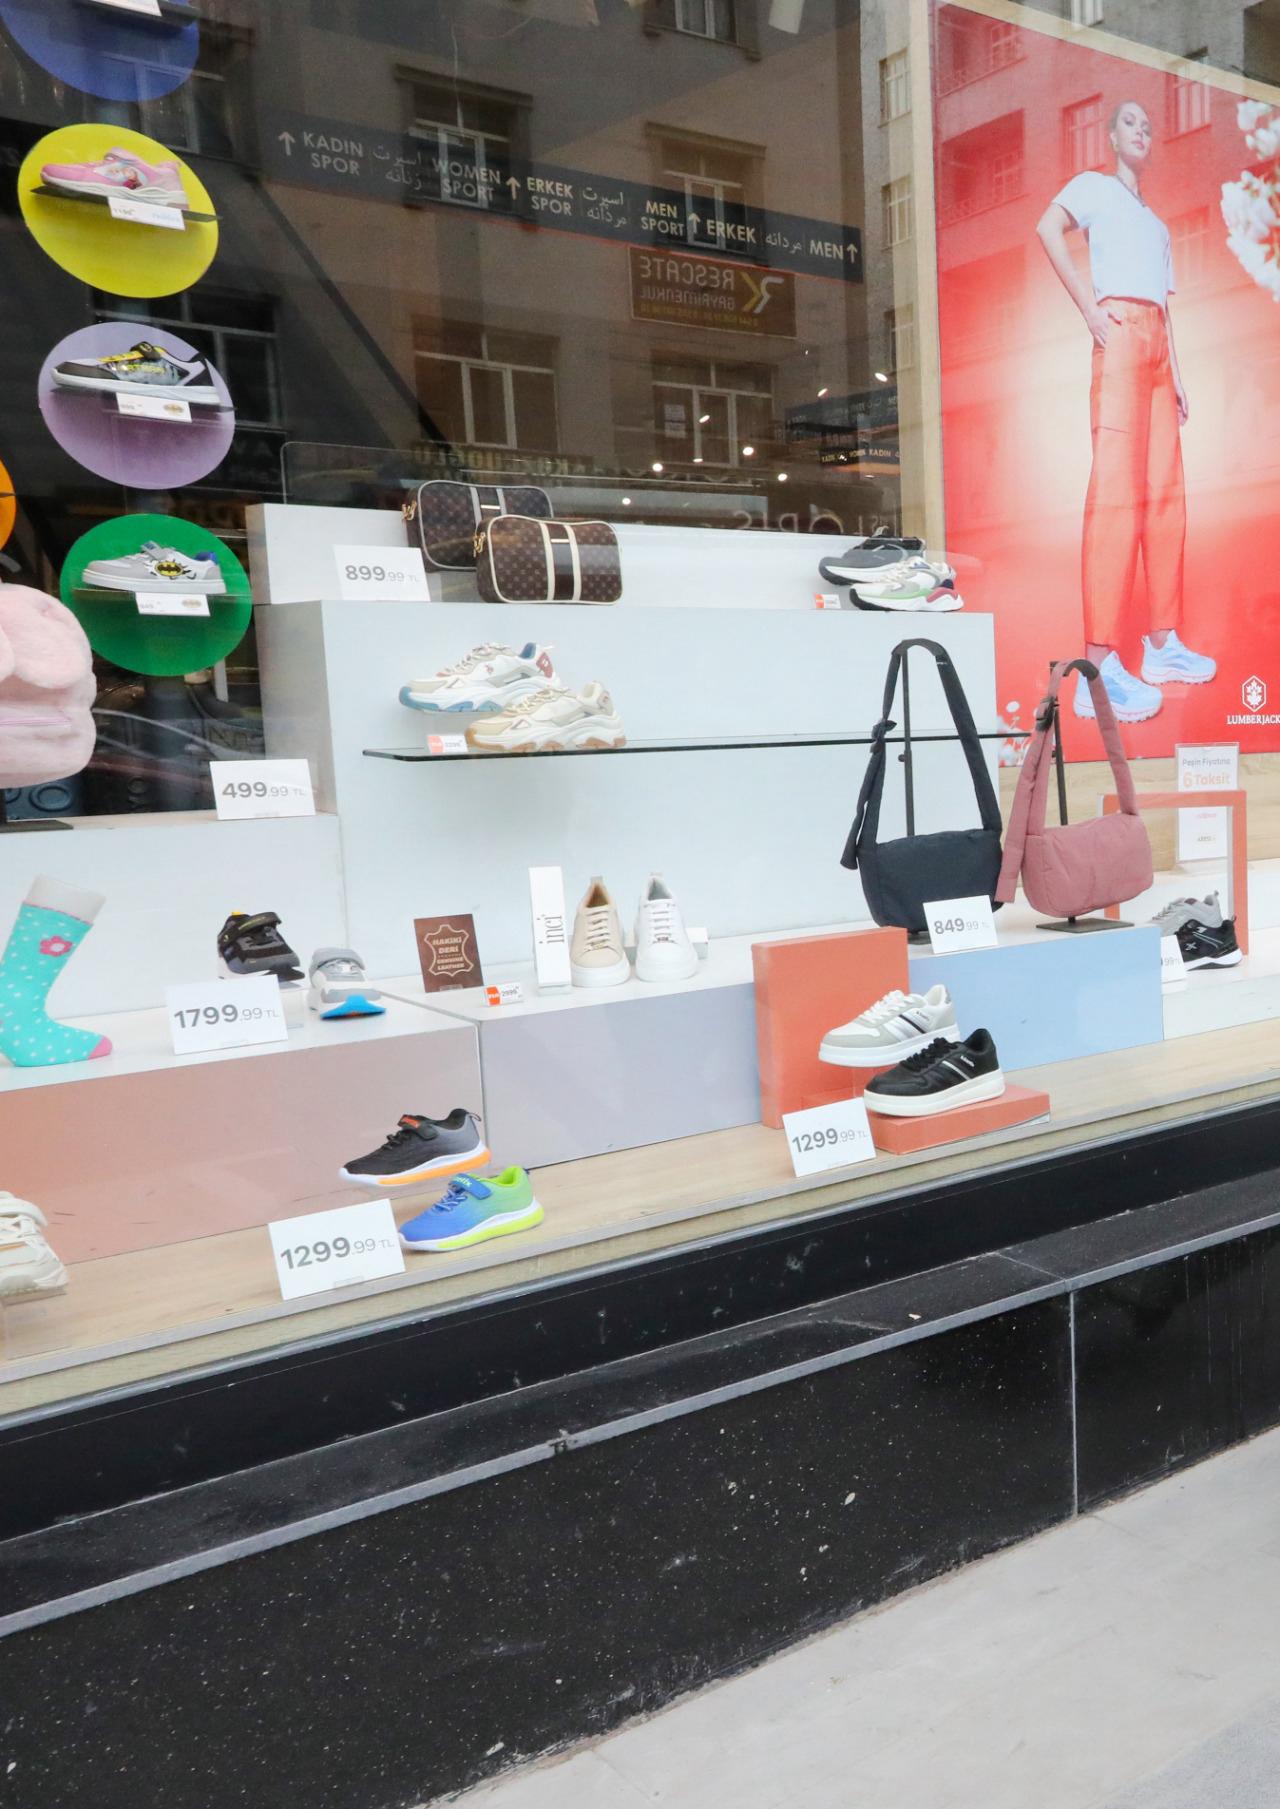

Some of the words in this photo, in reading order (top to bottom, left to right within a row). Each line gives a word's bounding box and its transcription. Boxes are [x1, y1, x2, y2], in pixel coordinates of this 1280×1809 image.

[303, 131, 363, 157] KADIN
[311, 153, 361, 176] SPOR
[432, 157, 501, 184] WOMEN
[443, 178, 495, 202] SPORT
[527, 177, 573, 199] ERKEK
[531, 196, 572, 216] SPOR
[645, 200, 678, 218] MEN
[641, 215, 685, 236] SPORT
[706, 220, 756, 244] ERKEK
[809, 240, 844, 260] MEN
[1183, 772, 1193, 788] 6
[1195, 771, 1231, 785] Taksit
